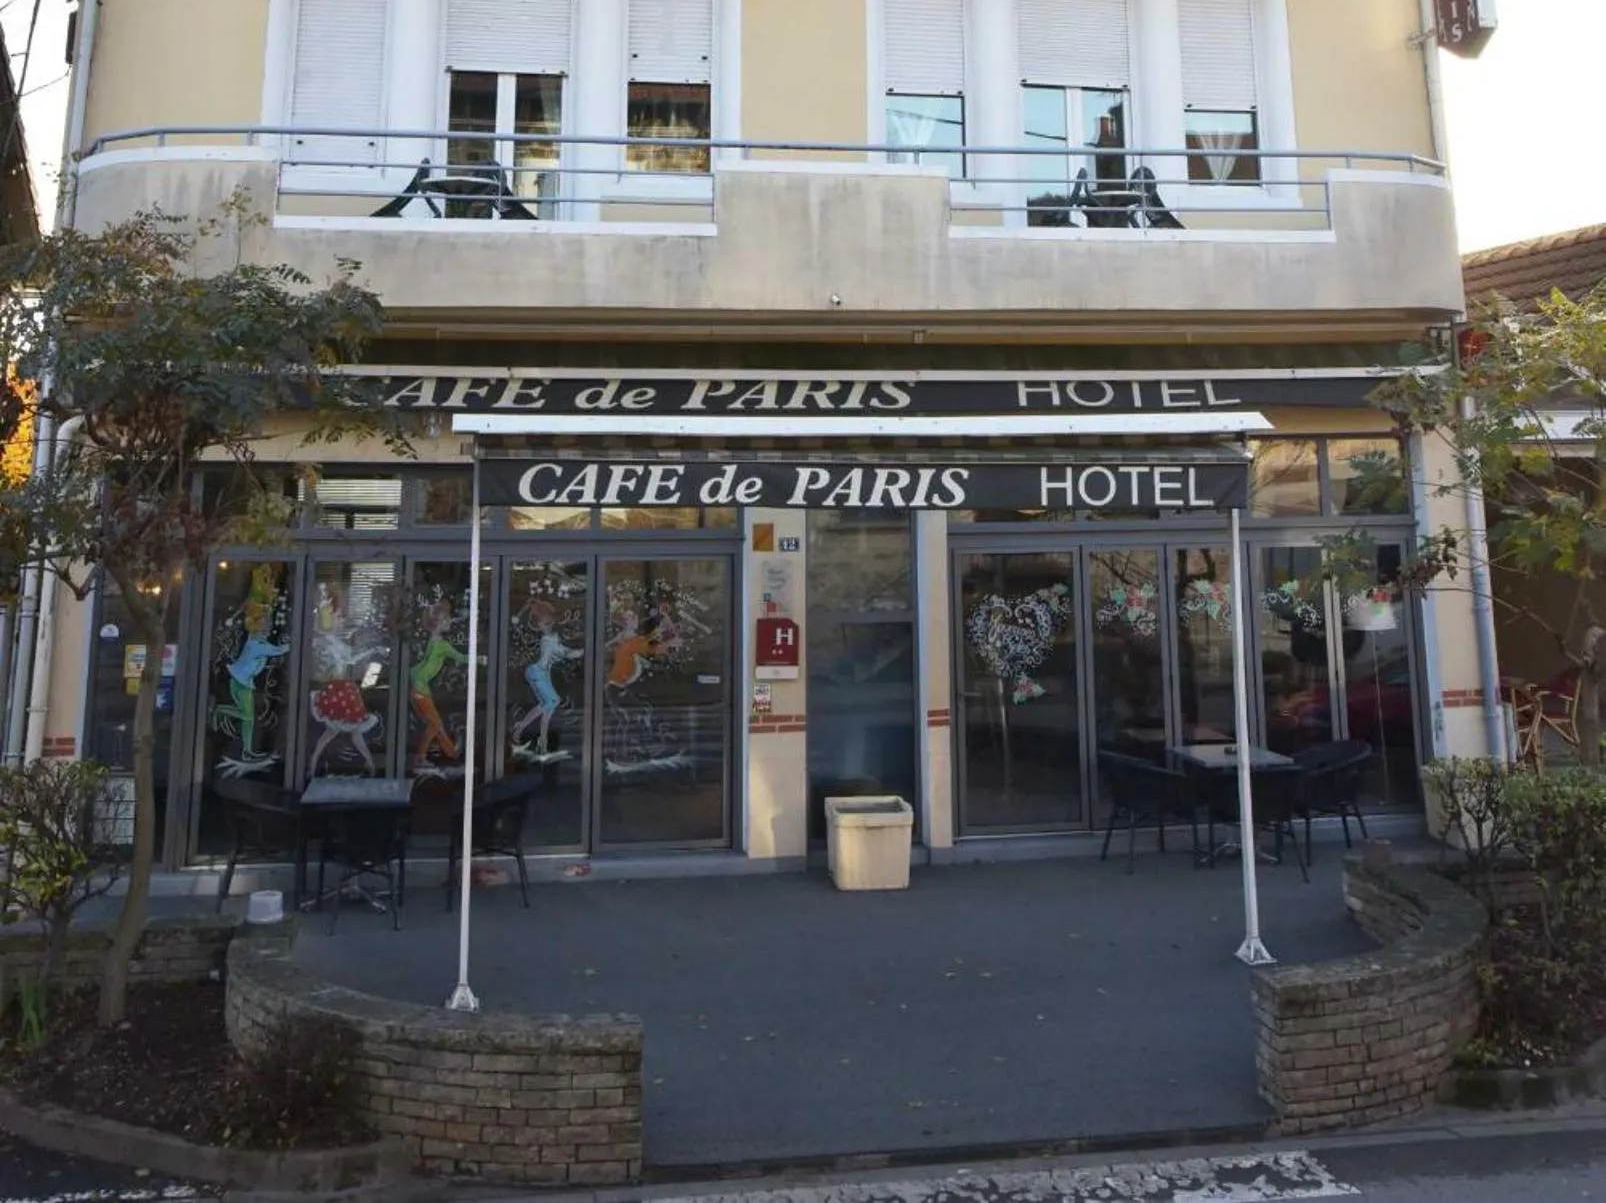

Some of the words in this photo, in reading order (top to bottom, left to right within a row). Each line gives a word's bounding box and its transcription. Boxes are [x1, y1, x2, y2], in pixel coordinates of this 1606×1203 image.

[574, 379, 657, 409] de
[680, 379, 917, 409] PARIS
[1016, 380, 1241, 408] HOTEL
[518, 463, 684, 504] CAFE
[699, 464, 763, 504] de
[786, 466, 969, 507] PARIS
[1040, 465, 1214, 506] HOTEL
[775, 627, 793, 646] H
